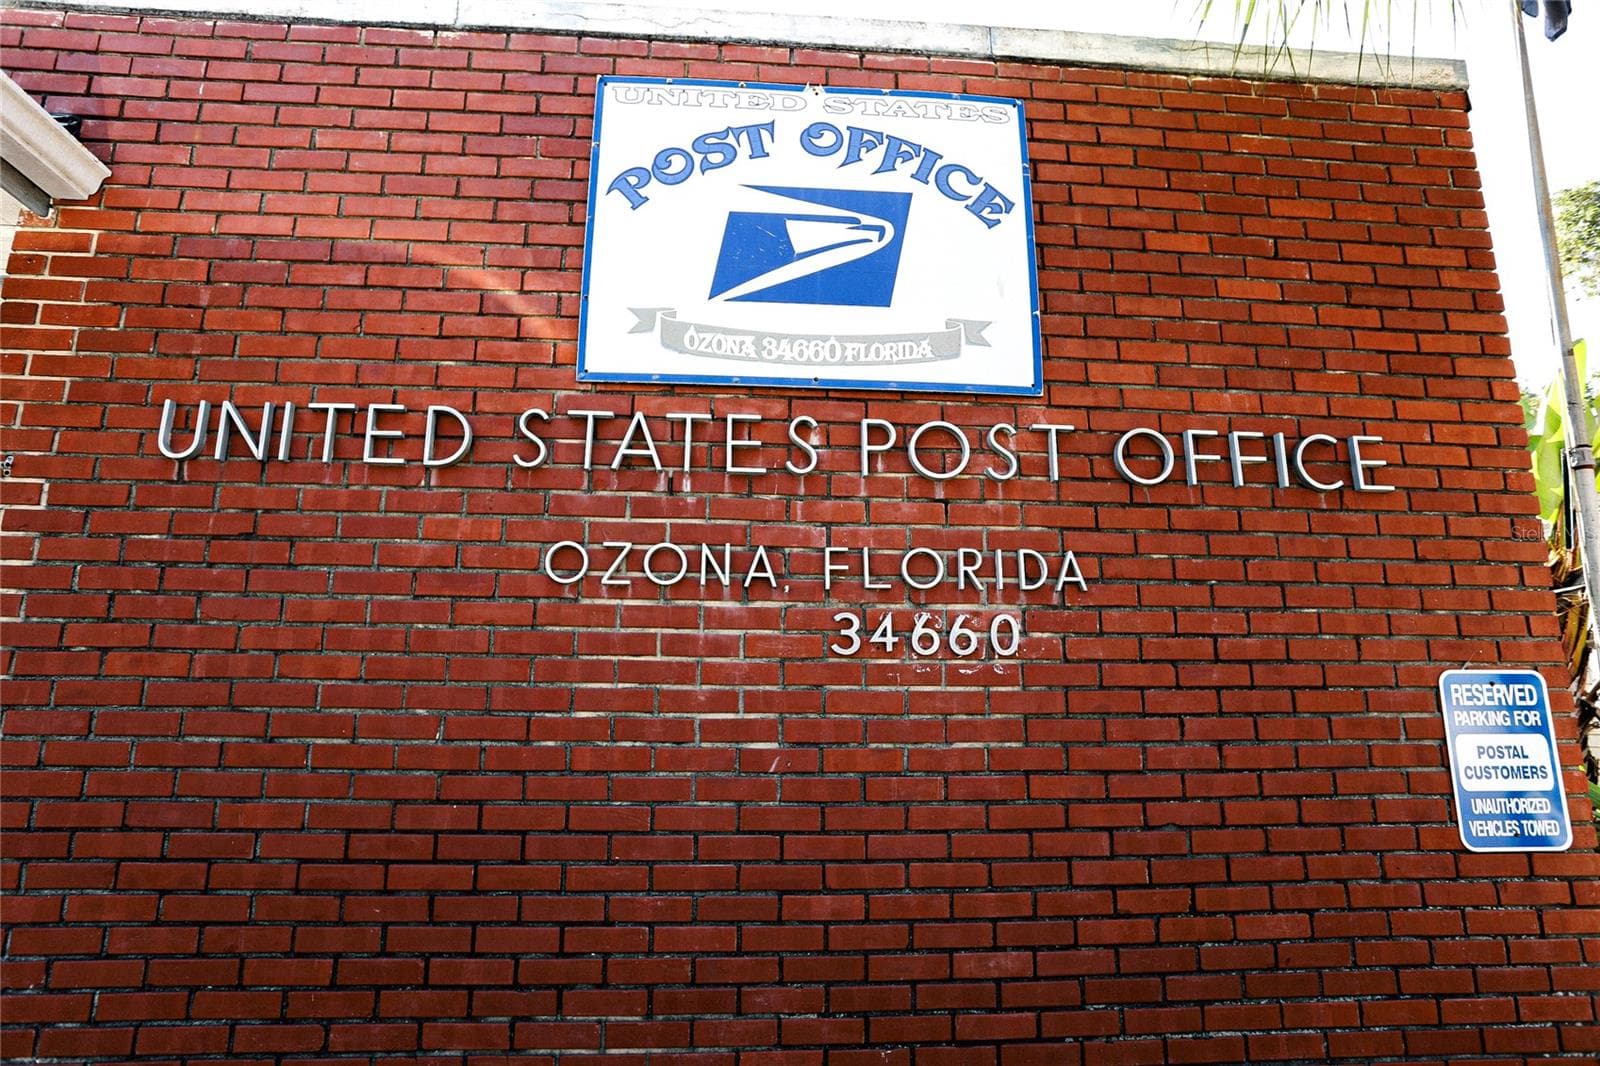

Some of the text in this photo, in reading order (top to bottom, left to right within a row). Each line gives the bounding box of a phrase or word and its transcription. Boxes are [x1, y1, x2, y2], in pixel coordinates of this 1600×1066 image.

[612, 86, 1011, 124] UNITED STATES
[606, 119, 1016, 230] POST OFFICE
[683, 325, 935, 363] OZONA 34660 FLORIDA
[157, 399, 1396, 492] UNITED STATES POST OFFICE
[544, 540, 1089, 594] OZONA, FLORIDA
[831, 611, 1021, 657] 34660
[1450, 684, 1538, 706] RESERVED
[1454, 710, 1542, 727] PARKING FOR
[1476, 745, 1529, 760] POSTAL
[1464, 765, 1548, 780] CUSTOMERS
[1471, 798, 1551, 814] UNAUTHORIZED
[1469, 819, 1560, 837] VEHICLES TOWED
